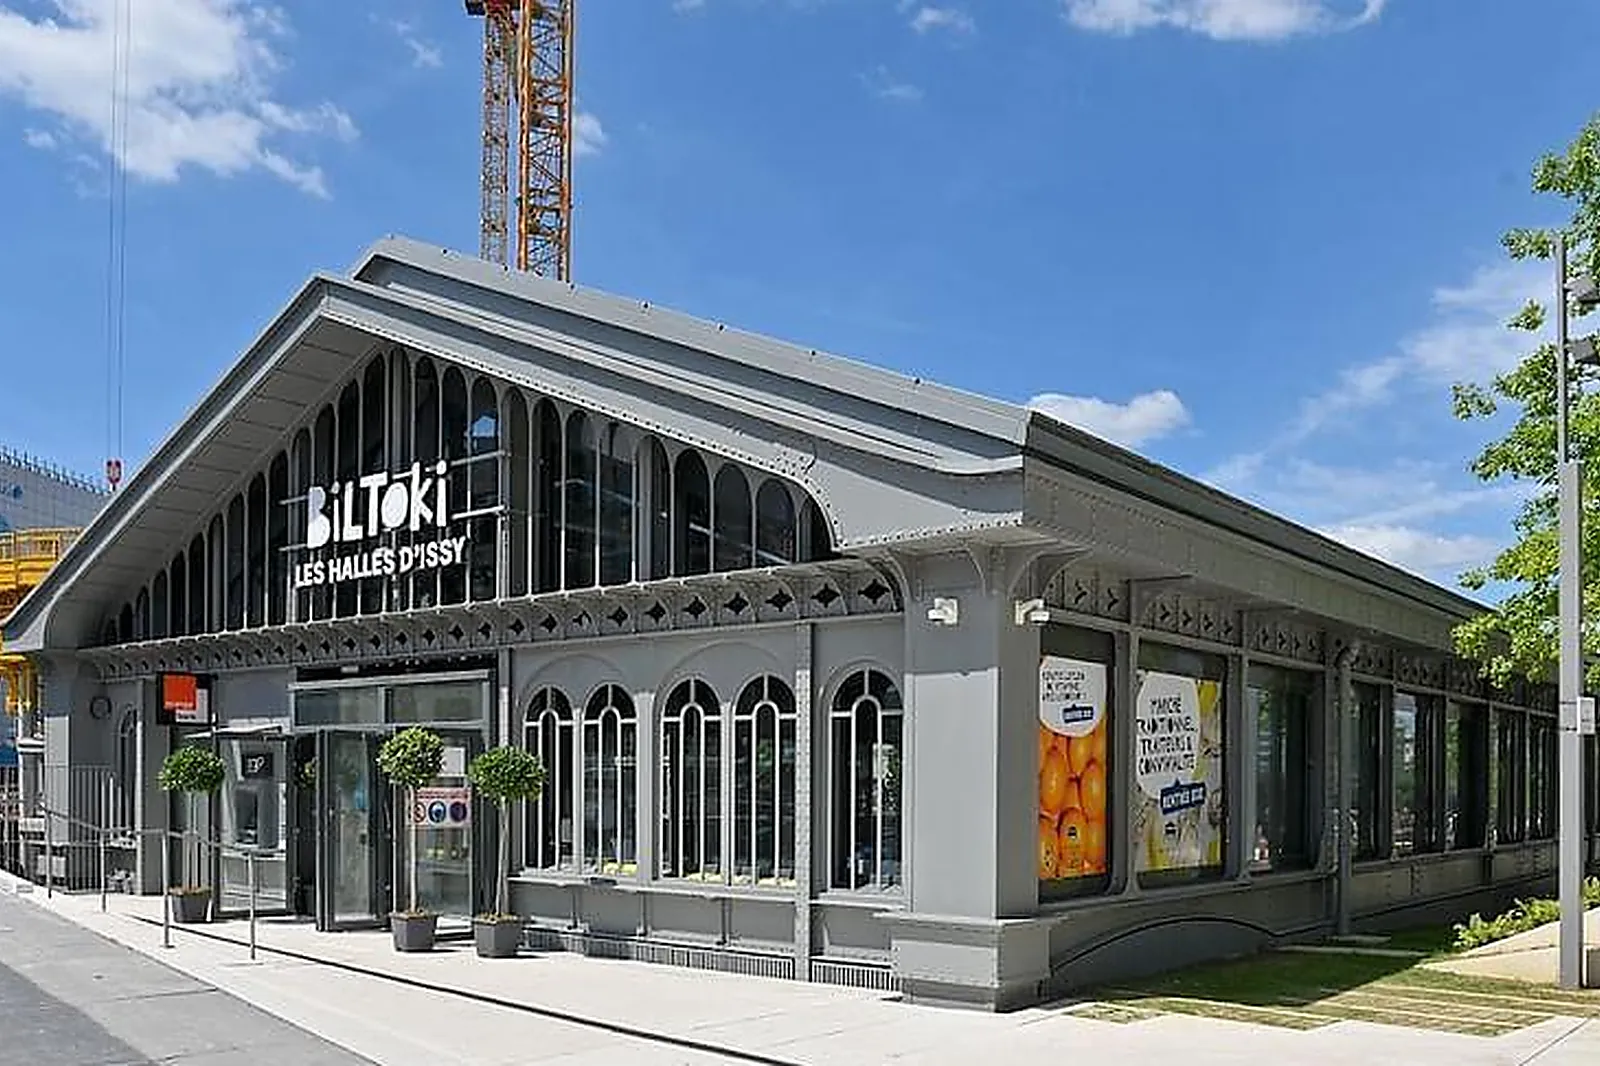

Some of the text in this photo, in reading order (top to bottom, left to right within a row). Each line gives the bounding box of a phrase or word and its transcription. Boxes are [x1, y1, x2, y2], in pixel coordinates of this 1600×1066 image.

[295, 536, 467, 589] LES HALLES D'ISSY
